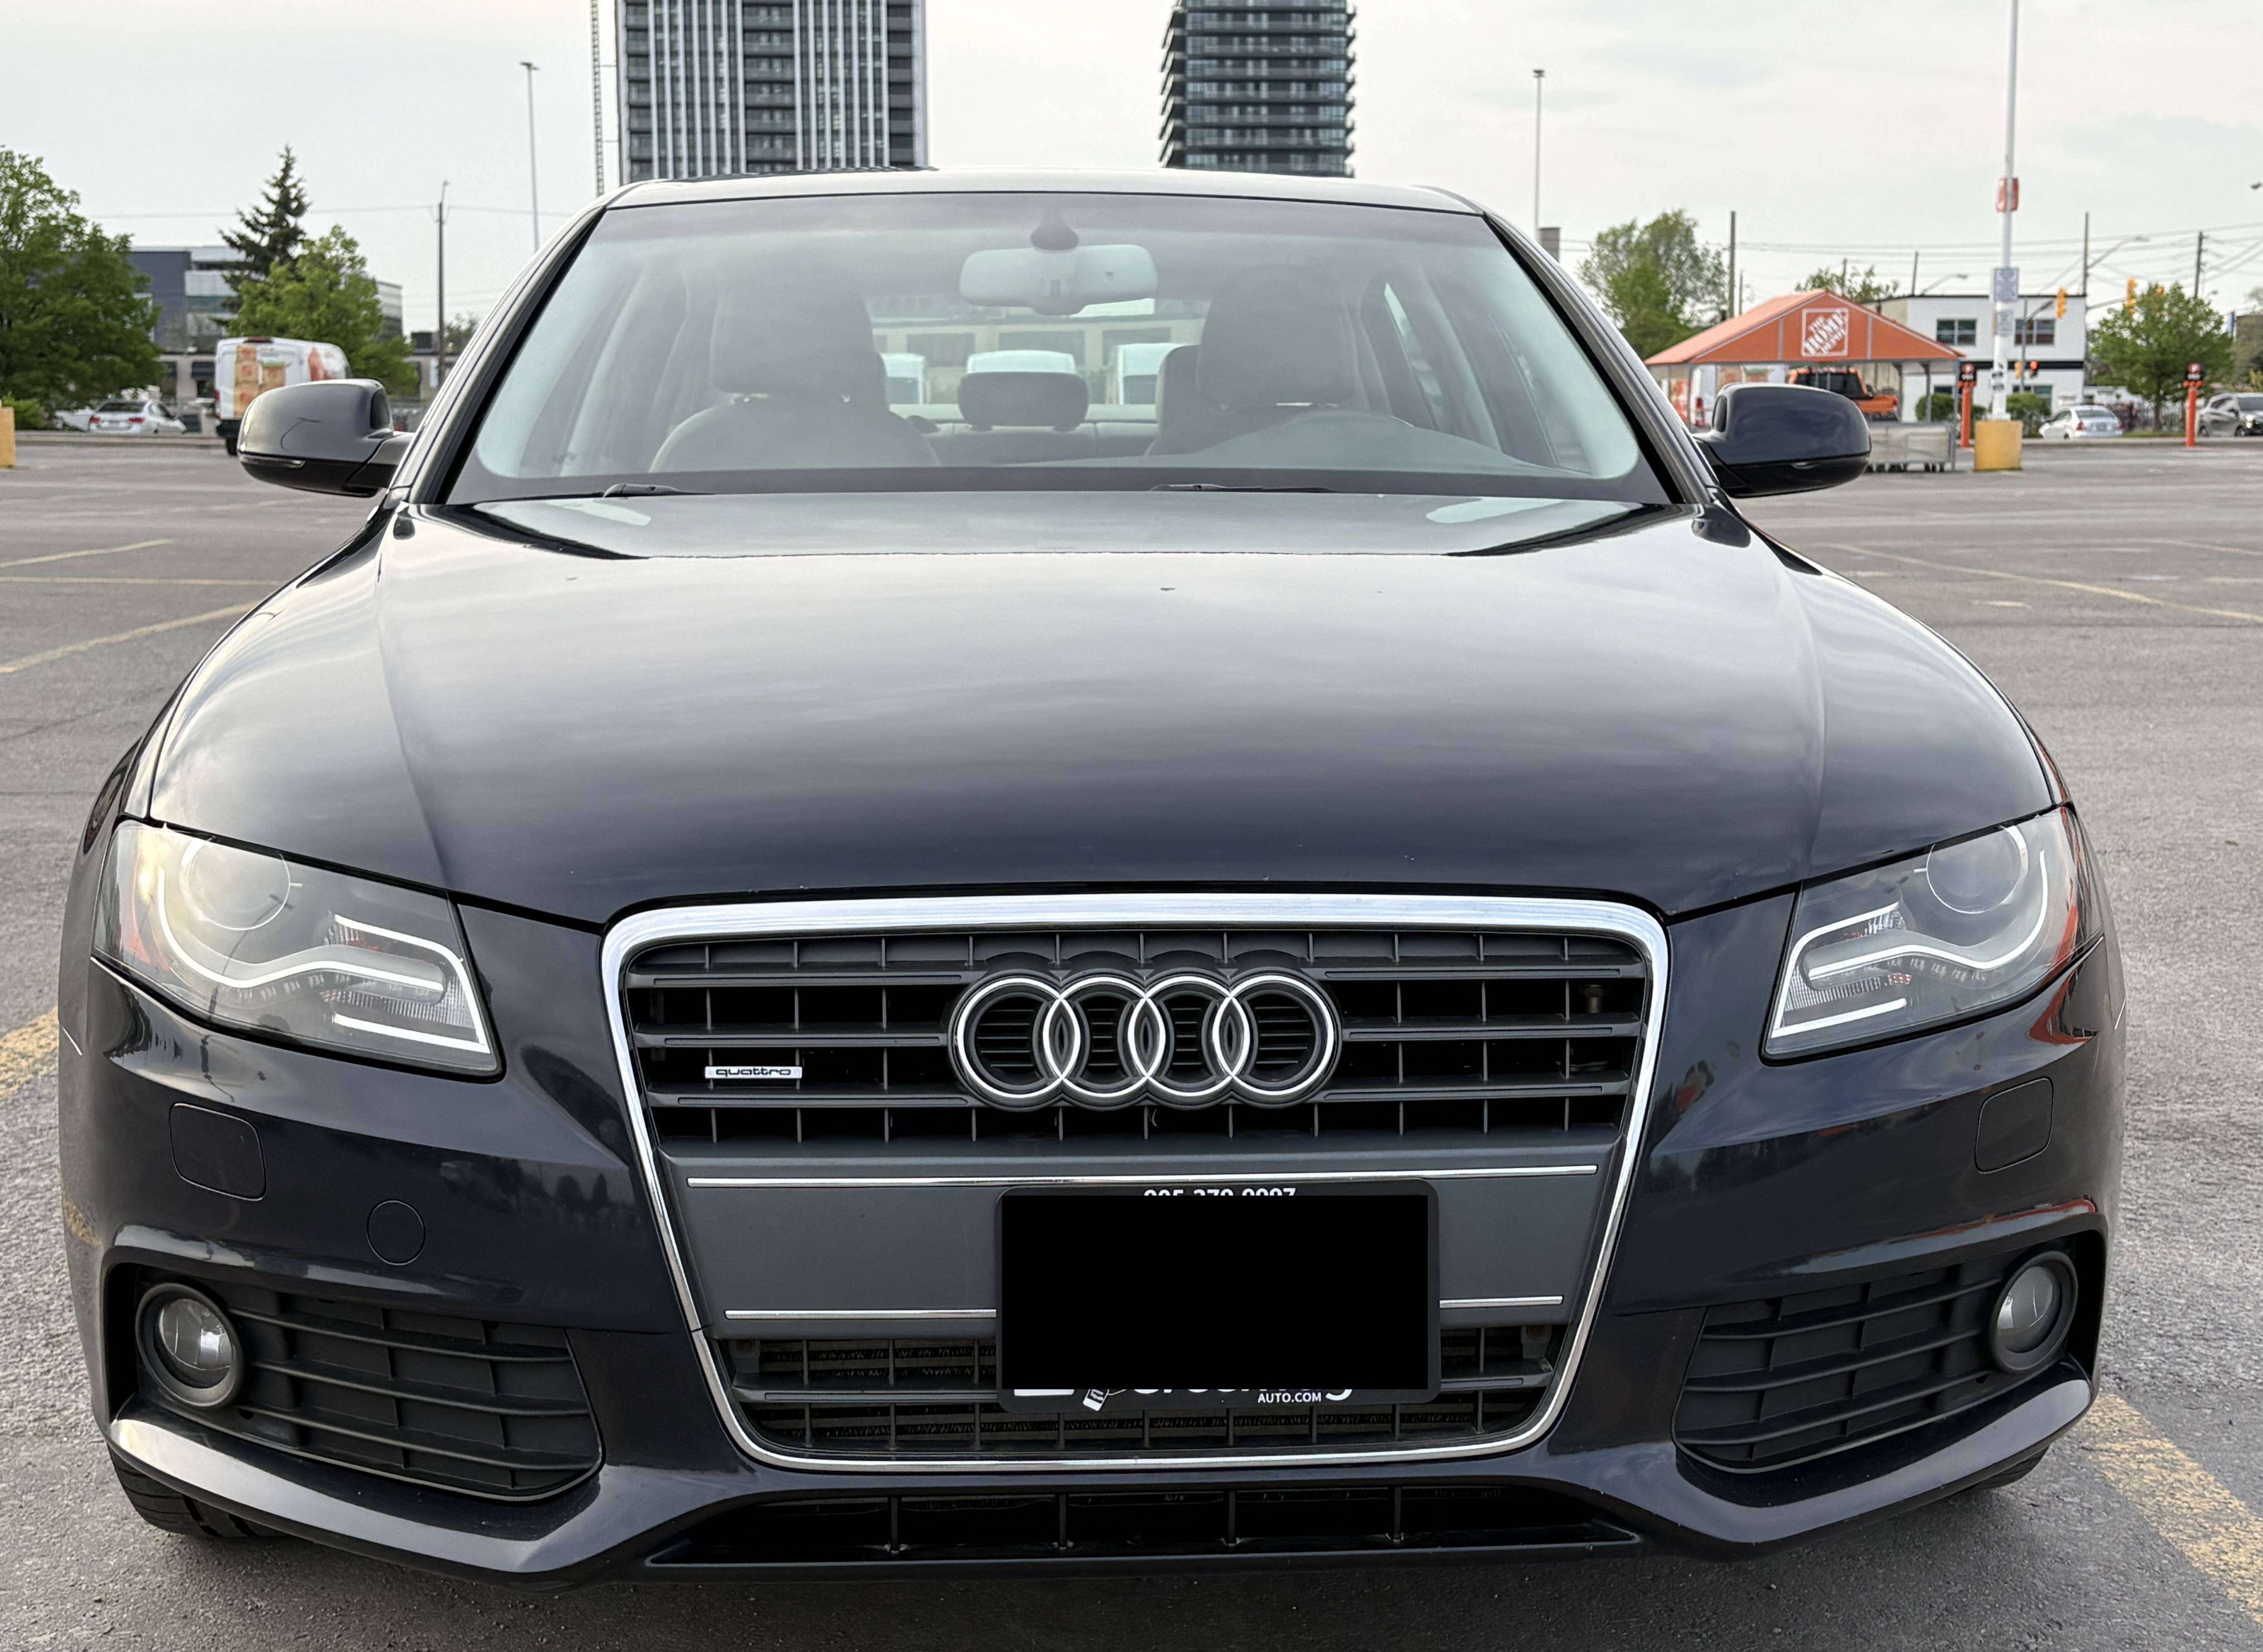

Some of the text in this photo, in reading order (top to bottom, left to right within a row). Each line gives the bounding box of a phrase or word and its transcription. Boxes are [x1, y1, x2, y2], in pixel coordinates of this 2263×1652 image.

[1804, 309, 1848, 355] HOME
[716, 1068, 791, 1077] quattro
[1258, 1392, 1321, 1403] AUTO.COM
